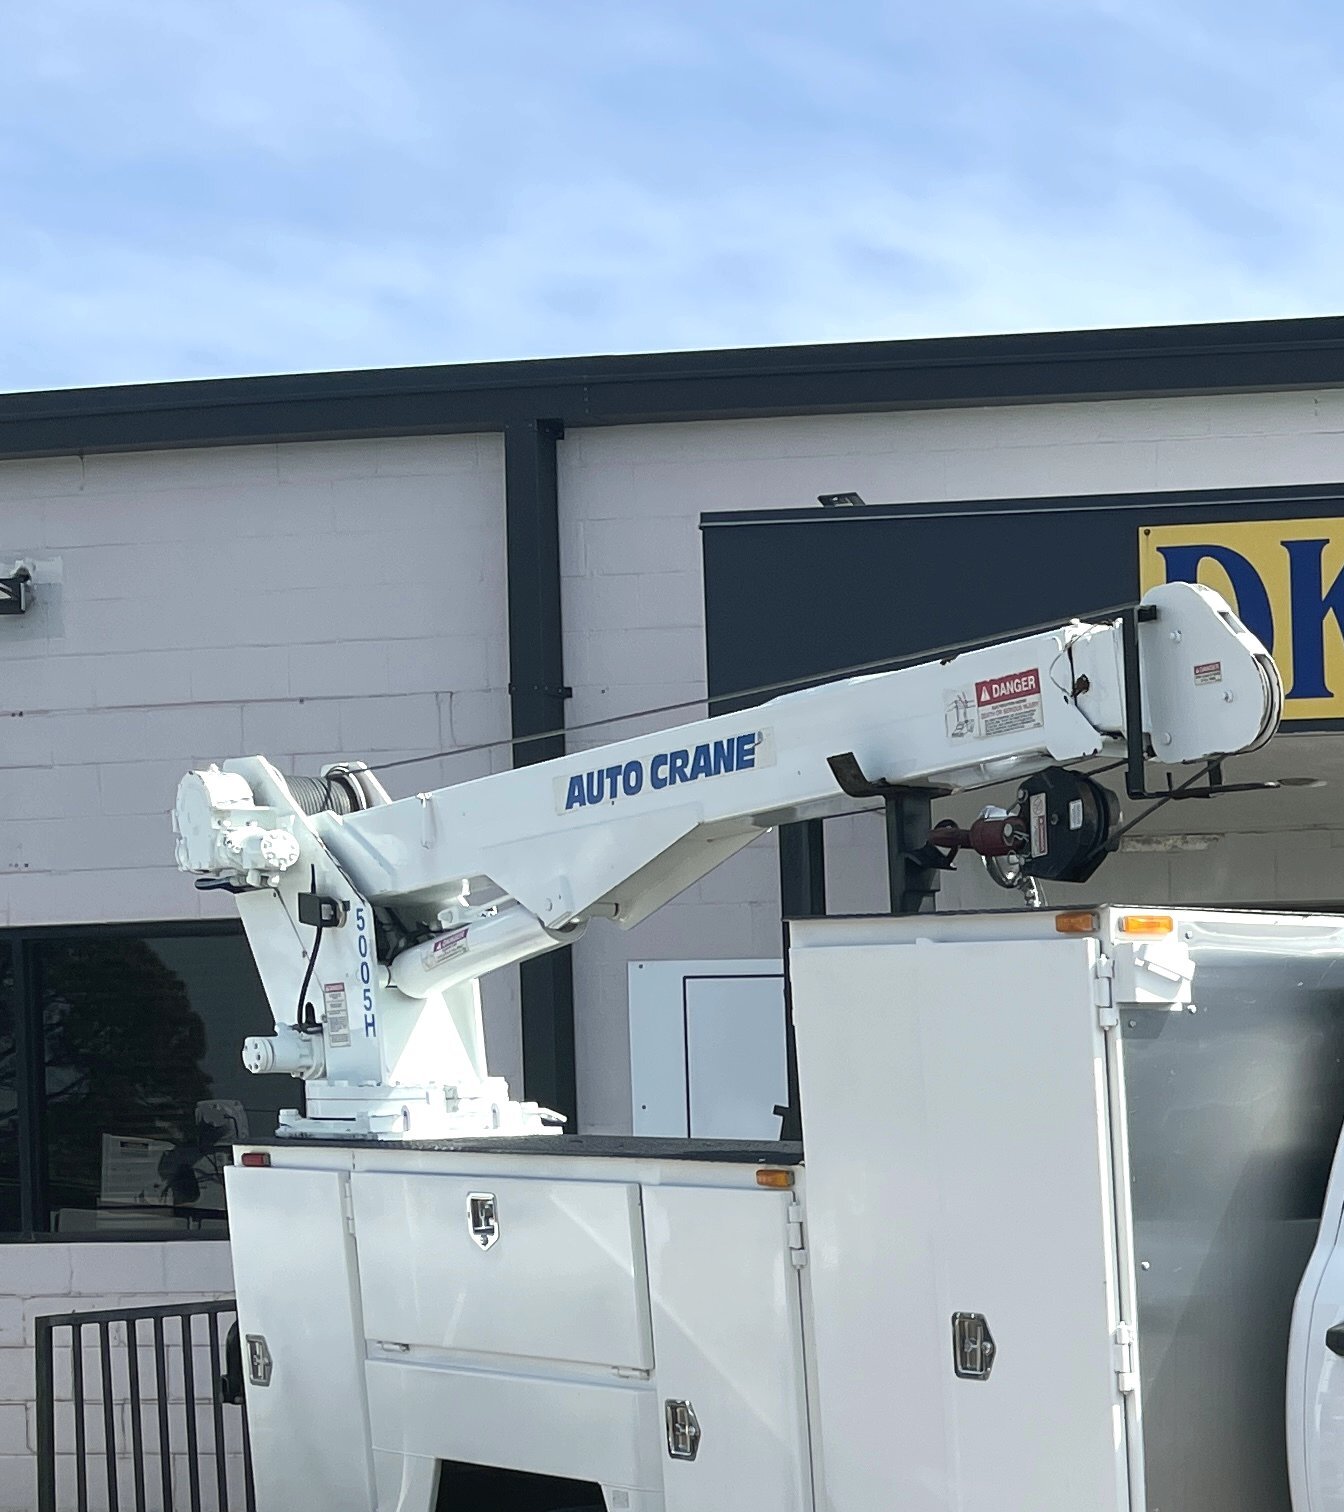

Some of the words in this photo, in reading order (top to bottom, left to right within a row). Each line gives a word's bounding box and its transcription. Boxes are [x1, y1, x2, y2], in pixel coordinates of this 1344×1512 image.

[992, 675, 1036, 698] DANGER
[565, 760, 643, 810] AUTO
[650, 732, 756, 790] CRANE
[355, 908, 377, 1038] 5005H
